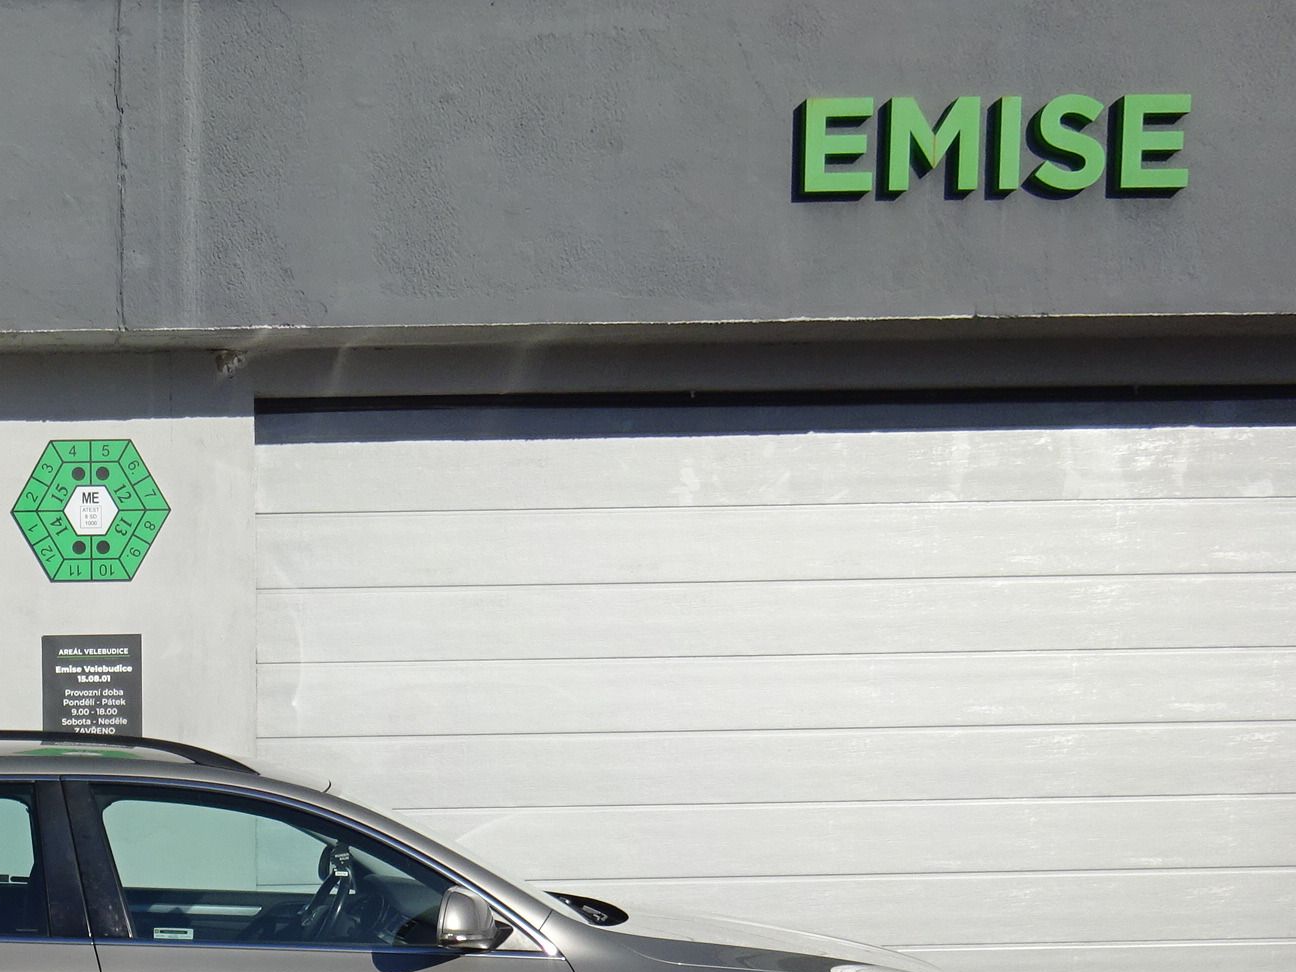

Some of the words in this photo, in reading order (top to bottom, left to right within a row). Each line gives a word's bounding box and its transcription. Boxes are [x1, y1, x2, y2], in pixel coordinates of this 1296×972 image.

[799, 94, 1192, 197] EMISE
[68, 444, 77, 457] 4
[101, 444, 110, 457] 5
[41, 463, 54, 474] 3
[25, 491, 39, 503] 2
[50, 483, 69, 503] 15
[81, 491, 100, 504] ME
[113, 483, 132, 503] 12
[144, 489, 157, 498] 7
[27, 523, 39, 534] 1
[49, 516, 69, 537] 14
[114, 517, 133, 537] 13
[144, 521, 156, 531] 8
[40, 545, 56, 563] 12
[69, 564, 83, 577] 11
[99, 563, 115, 577] 10
[58, 647, 83, 656] AREÁL
[83, 647, 129, 655] VELEBUDICE
[55, 665, 82, 674] Emise
[83, 664, 133, 673] Velebudice
[77, 674, 111, 683] 15.08.01
[64, 688, 101, 697] Provozní
[102, 688, 124, 696] doba
[63, 698, 95, 707] Pondělí
[101, 698, 126, 706] Pátek
[71, 708, 90, 716] 9.00
[96, 707, 118, 716] 18.00
[61, 717, 91, 726] Sobota
[98, 717, 128, 725] Neděle
